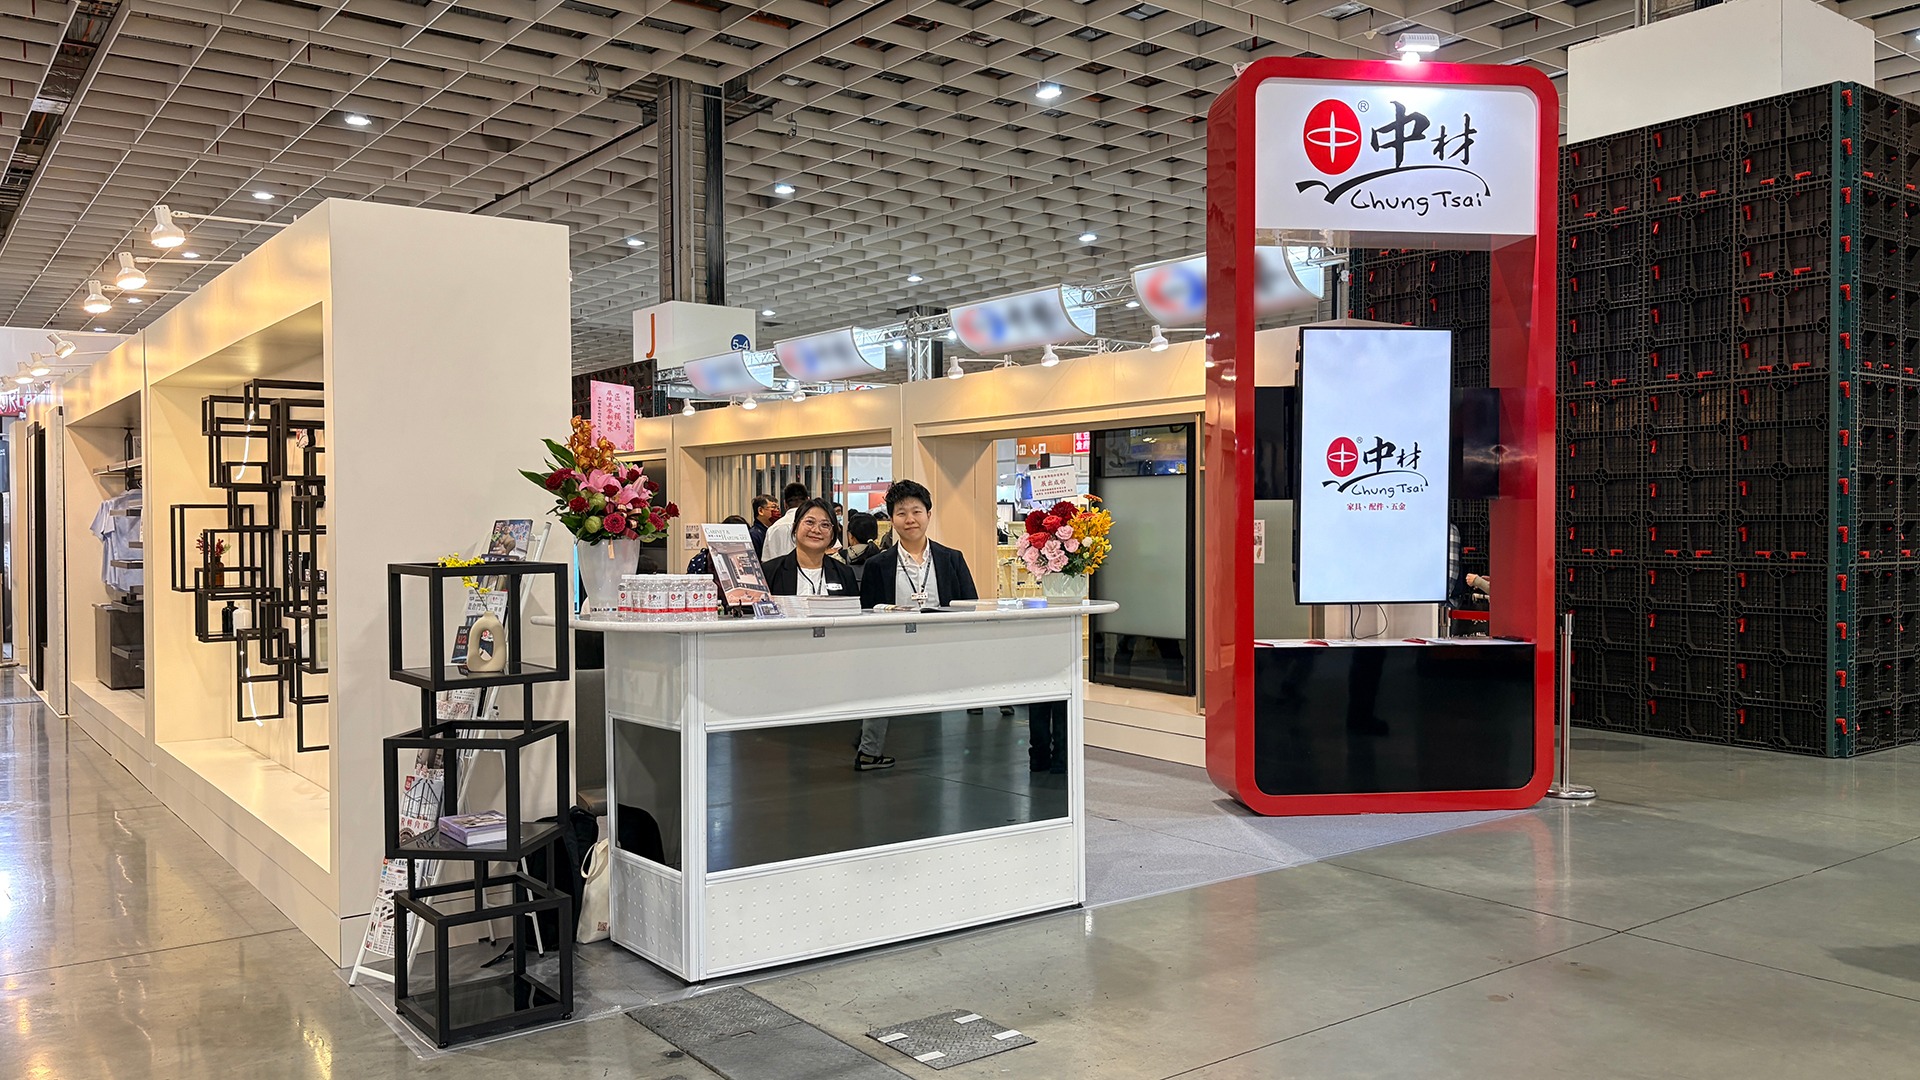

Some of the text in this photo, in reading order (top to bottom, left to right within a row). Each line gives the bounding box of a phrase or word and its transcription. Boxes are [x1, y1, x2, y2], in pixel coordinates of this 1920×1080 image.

[1371, 101, 1478, 168] 中材
[1350, 189, 1483, 217] Chung Tsai
[646, 313, 655, 359] J
[732, 339, 749, 350] 5-4
[1363, 436, 1422, 473] 中材
[1351, 484, 1424, 498] Chung Tsai
